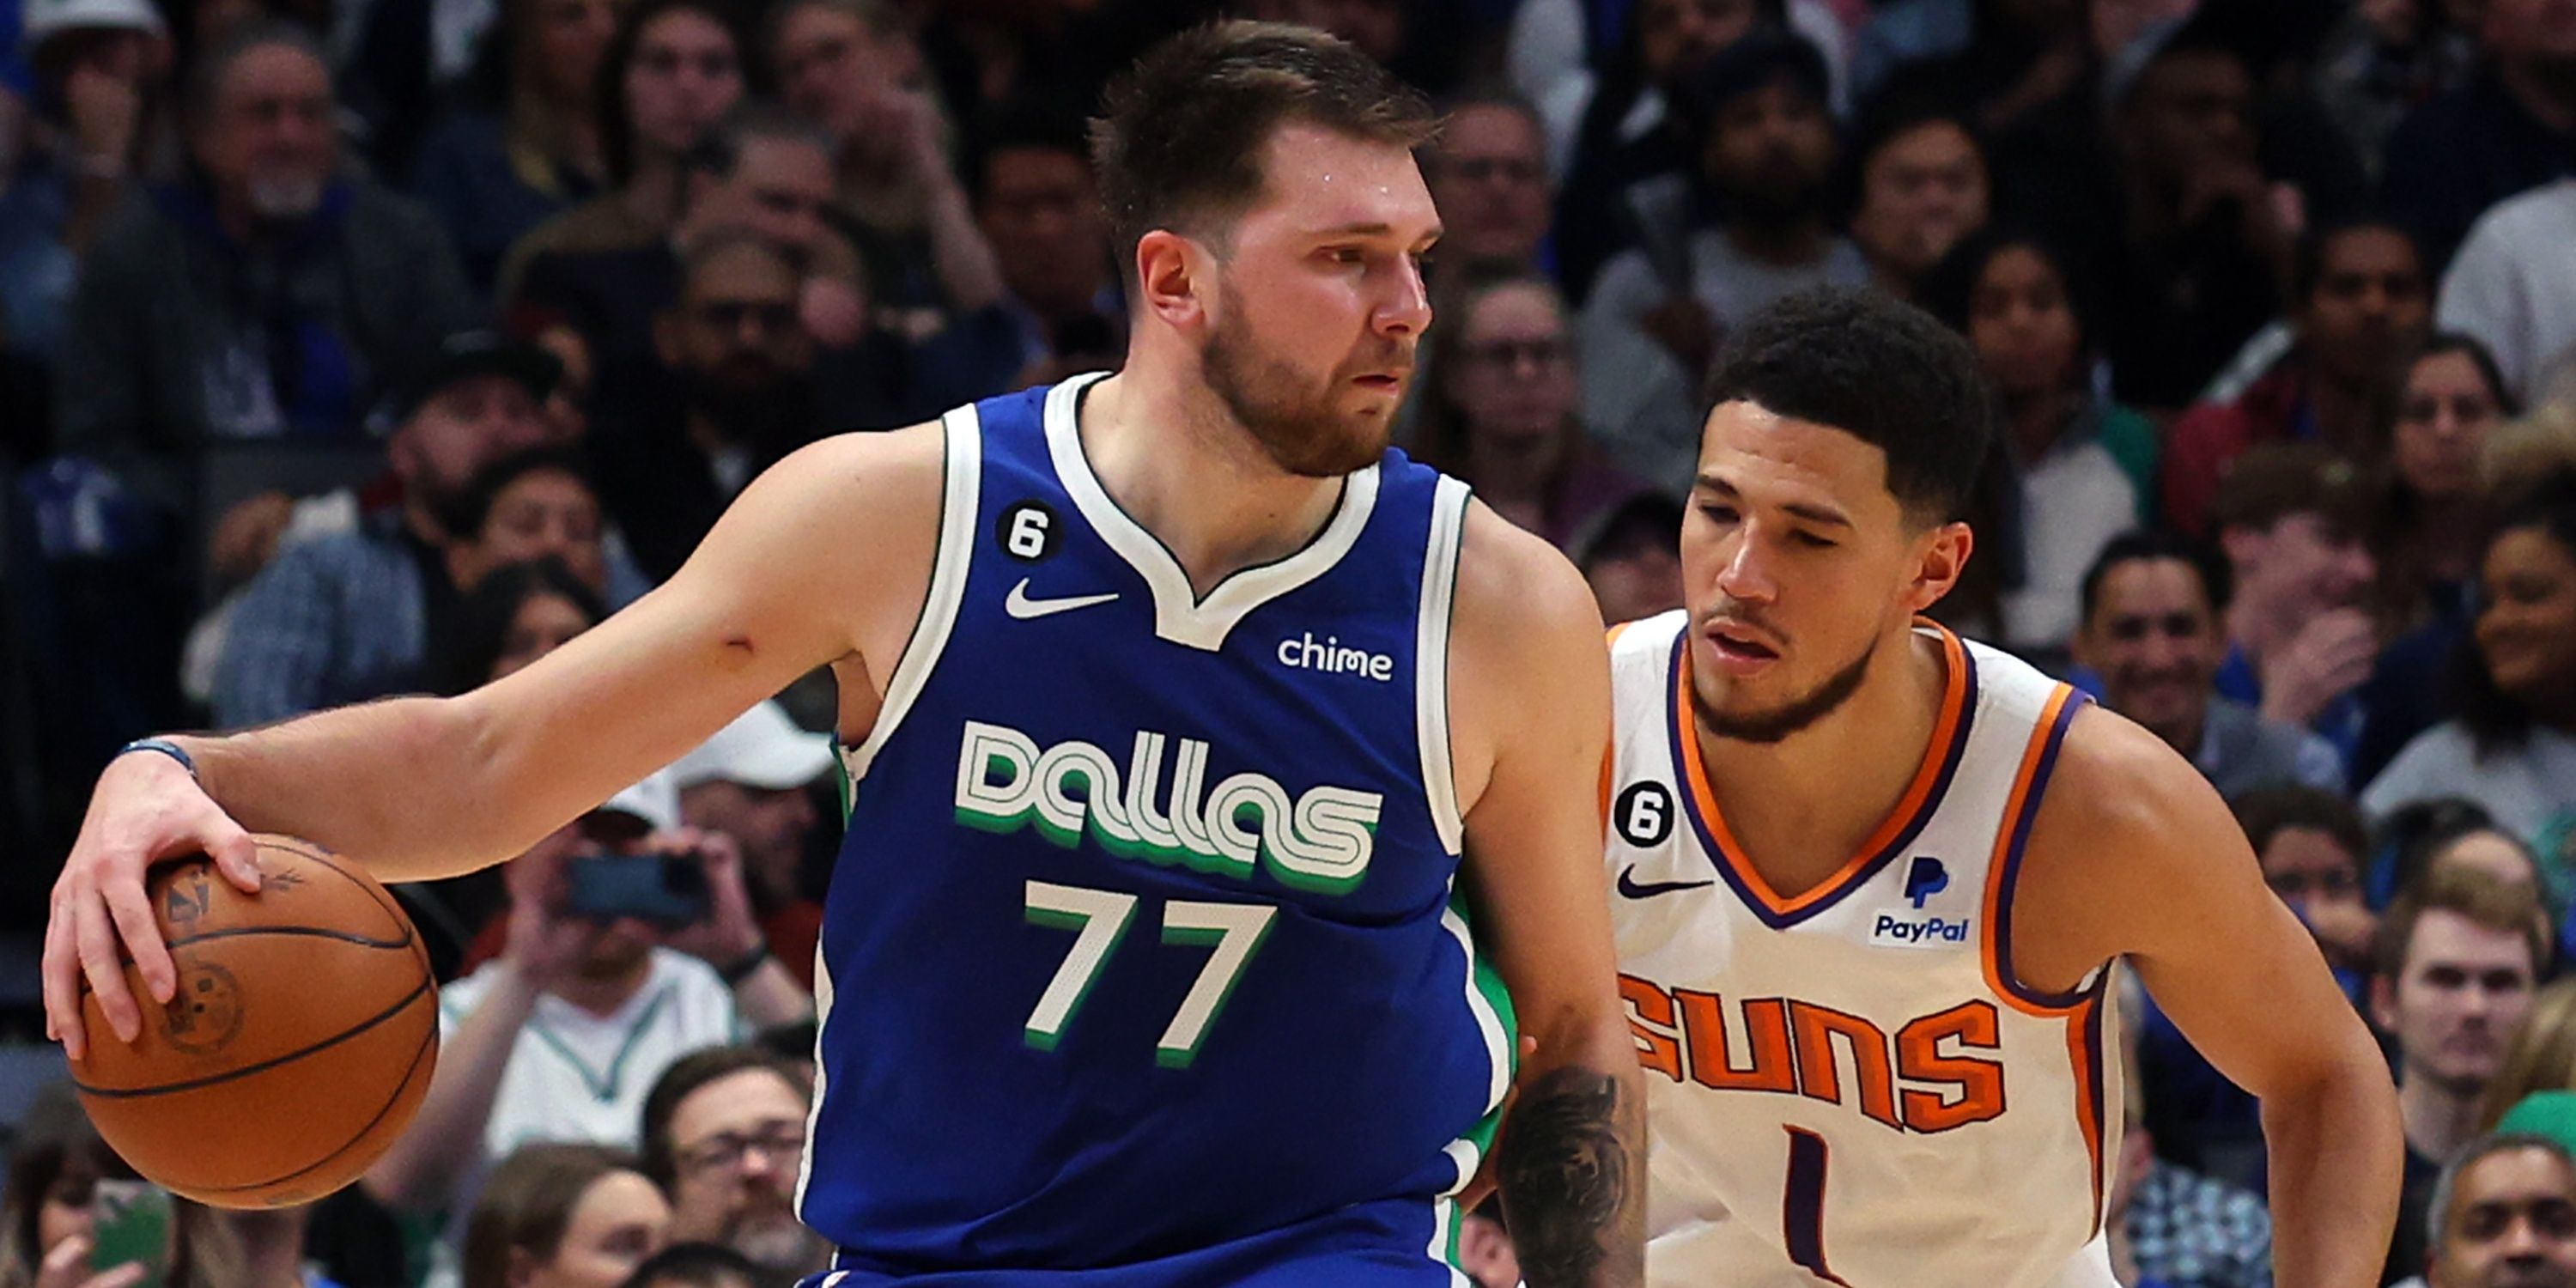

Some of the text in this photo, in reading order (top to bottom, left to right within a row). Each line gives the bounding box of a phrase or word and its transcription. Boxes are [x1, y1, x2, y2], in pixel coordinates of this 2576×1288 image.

[1008, 507, 1049, 558] 6
[1278, 632, 1393, 681] chime
[955, 720, 1384, 896] Dallas
[1628, 790, 1664, 840] 6
[1874, 915, 1969, 943] PayPal
[1024, 879, 1279, 1069] 77
[1782, 1122, 1855, 1288] 1
